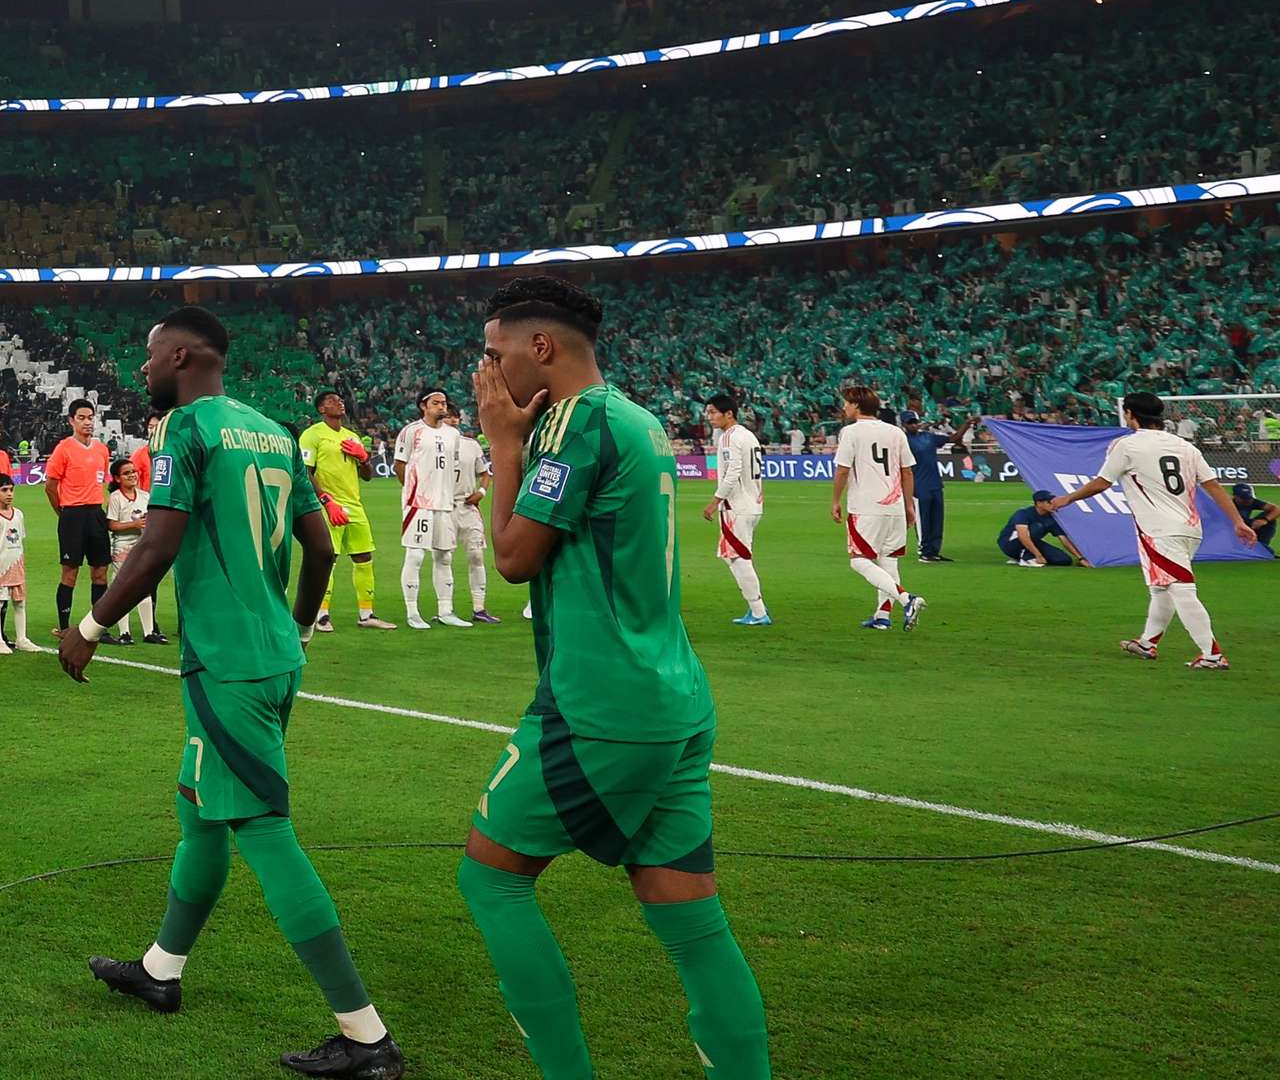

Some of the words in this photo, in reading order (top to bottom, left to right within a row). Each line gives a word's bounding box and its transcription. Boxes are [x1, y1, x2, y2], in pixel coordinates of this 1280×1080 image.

[435, 456, 446, 469] 16
[760, 461, 796, 478] EDIT
[871, 442, 890, 476] 4
[1159, 455, 1185, 496] 8
[244, 463, 293, 570] 17
[417, 519, 428, 533] 16
[190, 736, 204, 782] 7
[488, 742, 520, 792] 7
